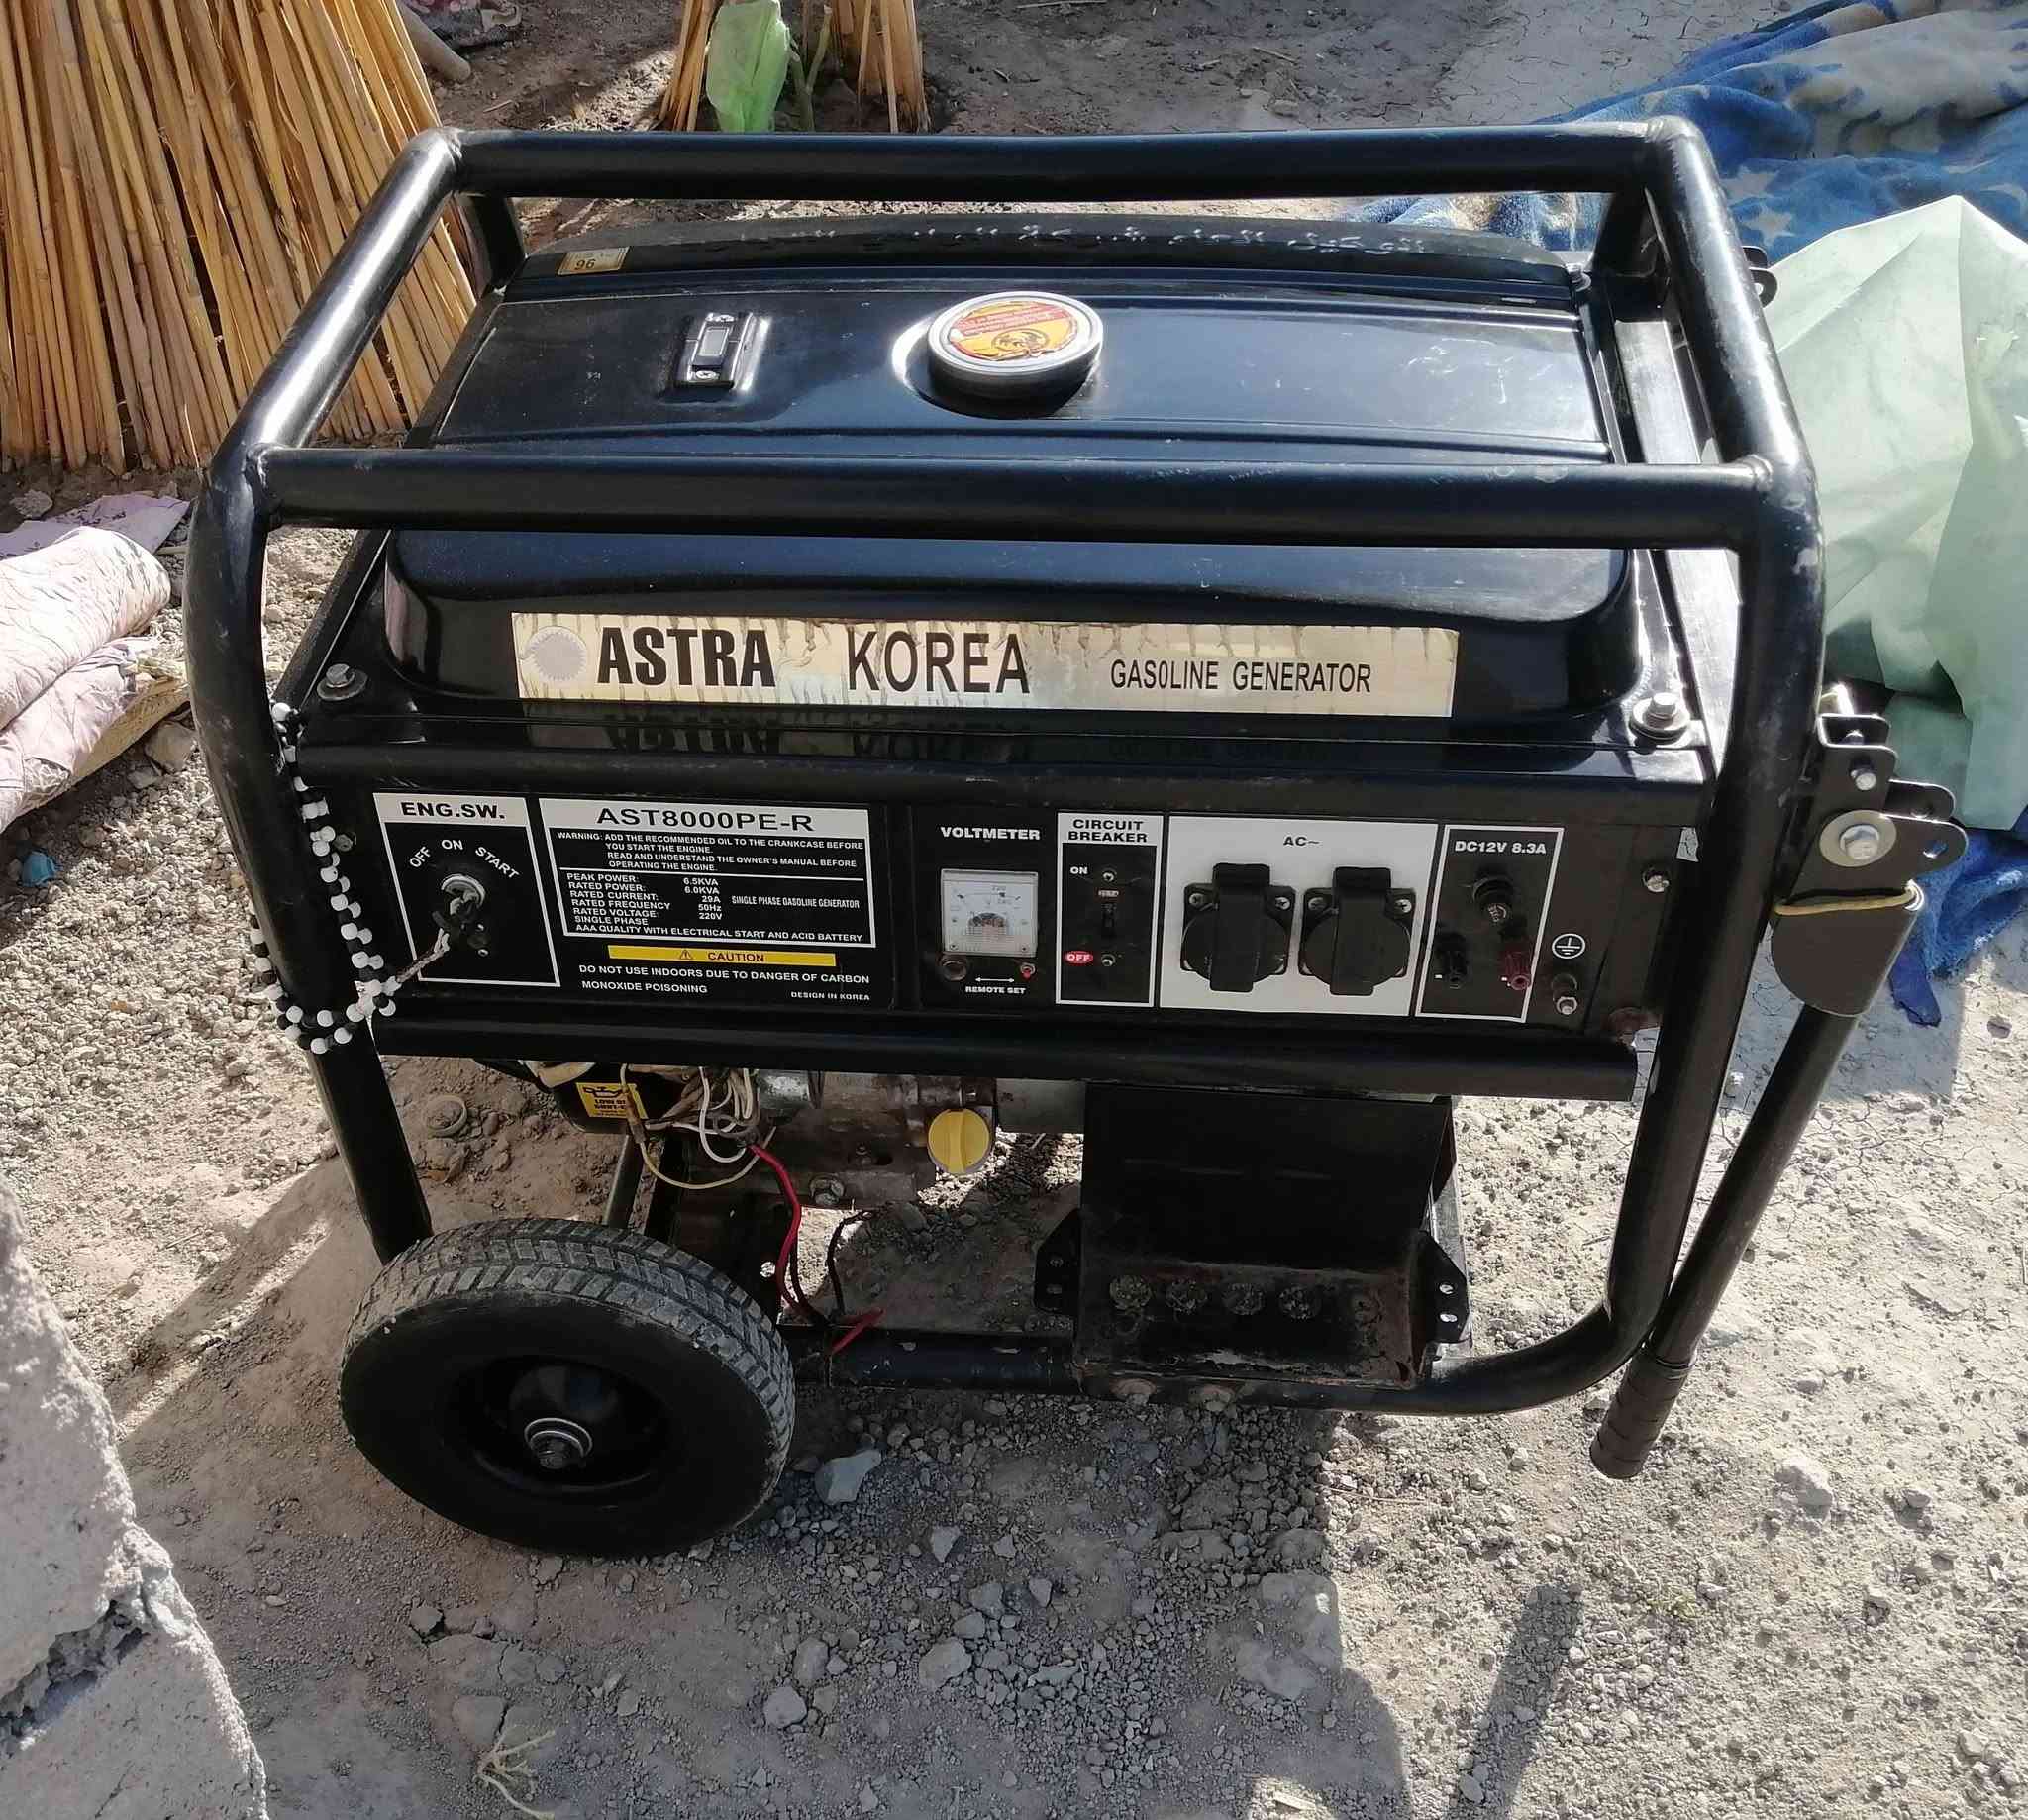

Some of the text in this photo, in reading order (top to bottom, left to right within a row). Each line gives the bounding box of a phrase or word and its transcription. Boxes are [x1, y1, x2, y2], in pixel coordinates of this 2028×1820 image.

[597, 626, 1030, 694] ASTRA KOREA
[1110, 659, 1371, 693] GASOLINE GENERATOR
[401, 802, 505, 819] ENG.SW.
[596, 807, 815, 832] AST8000PE-R
[1072, 819, 1144, 831] CIRCUIT
[940, 826, 1041, 841] VOLTMETER
[1067, 831, 1148, 843] BREAKER
[557, 831, 603, 841] WARNING:
[645, 835, 716, 845] RECOMMENDED
[767, 840, 825, 849] CRANKCASE
[826, 841, 863, 850] BEFORE
[676, 845, 714, 854] ENGINE.
[1454, 841, 1547, 855] DC12V 8.3A
[409, 839, 520, 879] OFF ON START
[655, 854, 715, 862] UNDERSTAND
[736, 857, 778, 865] OWNER'S
[780, 858, 819, 866] MANUAL
[820, 859, 857, 867] BEFORE
[609, 860, 660, 870] OPERATING
[1069, 866, 1088, 875] ON
[566, 872, 640, 883] PEAK POWER:
[683, 877, 719, 886] 6.5KVA
[605, 883, 647, 892] POWER:
[684, 886, 720, 895] 6.0KVA
[569, 890, 659, 901] RATED CURRENT:
[701, 895, 722, 904] 29A
[608, 900, 671, 910] FREQUENCY
[697, 903, 722, 912] 50Hz
[731, 895, 860, 909] SINGLE PHASE GASOLINE GENERATOR
[573, 907, 607, 916] RATED
[574, 916, 649, 926] SINGLE PHASE
[598, 925, 642, 934] QUALITY
[643, 926, 668, 935] WITH
[670, 927, 733, 938] ELECTRICAL
[734, 930, 766, 939] START
[768, 931, 789, 940] AND
[791, 932, 815, 941] ACID
[817, 933, 863, 942] BATTERY
[707, 952, 765, 962] CAUTION
[1066, 953, 1090, 961] OFF
[578, 964, 870, 984] DO NOT USE INDOORS DUE TO DANGER OF CARBON
[581, 980, 708, 993] MONOXIDE POISONING
[965, 985, 1005, 994] REMOTE
